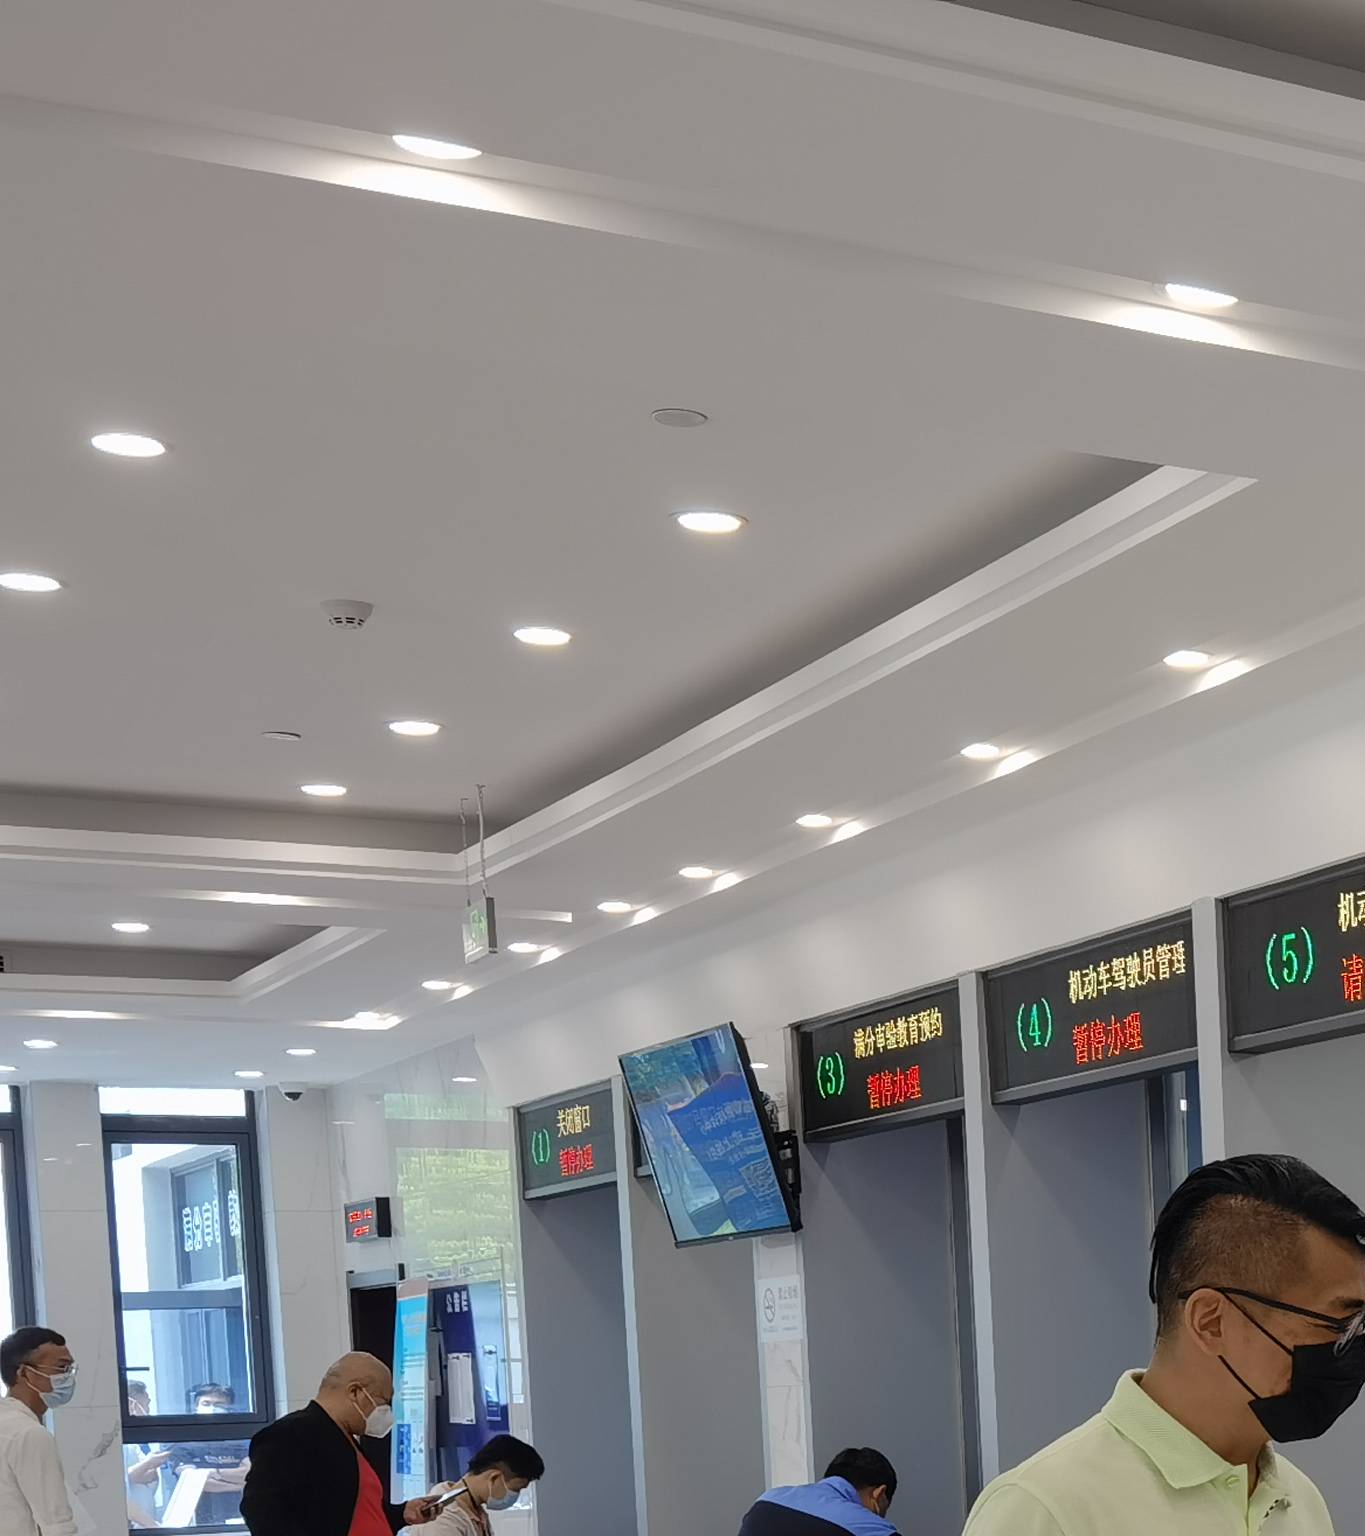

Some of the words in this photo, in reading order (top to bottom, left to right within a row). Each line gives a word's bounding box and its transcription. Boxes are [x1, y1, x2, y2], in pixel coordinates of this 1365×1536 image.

[1068, 940, 1186, 1003] 机动车驾驶员管理
[1265, 927, 1314, 989] (5)
[1017, 998, 1051, 1052] (4)
[1073, 1012, 1143, 1064] 暂停办理
[817, 1052, 844, 1098] (3)
[867, 1065, 921, 1109] 暂停办理
[557, 1104, 590, 1137] 关闭窗口
